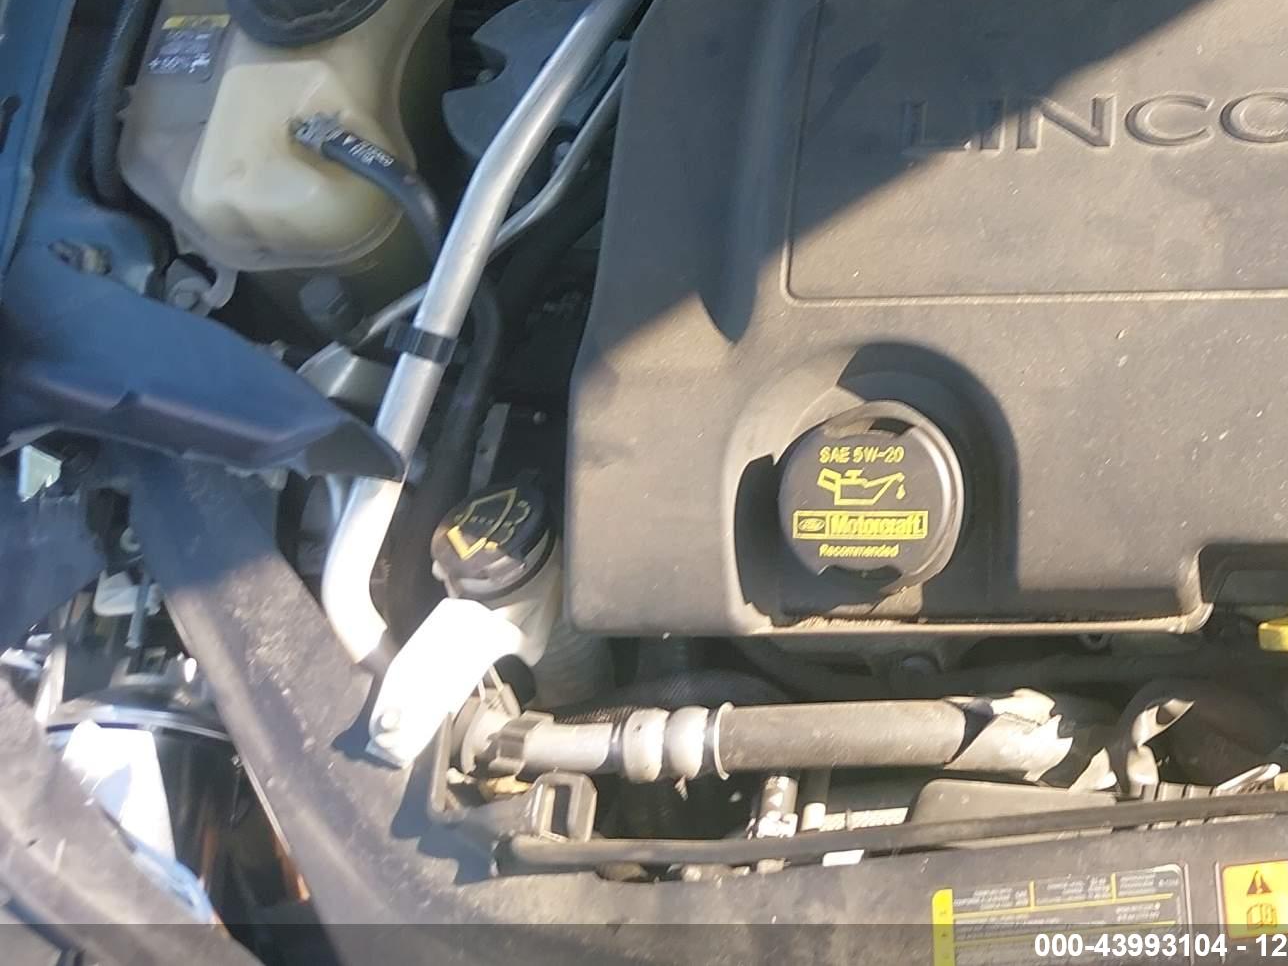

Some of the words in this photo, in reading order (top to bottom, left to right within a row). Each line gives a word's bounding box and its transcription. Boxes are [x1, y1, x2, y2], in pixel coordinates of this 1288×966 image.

[819, 446, 850, 463] SAE
[853, 445, 905, 463] 5W-20
[829, 514, 925, 535] Motorcraft
[819, 543, 900, 558] Recommended
